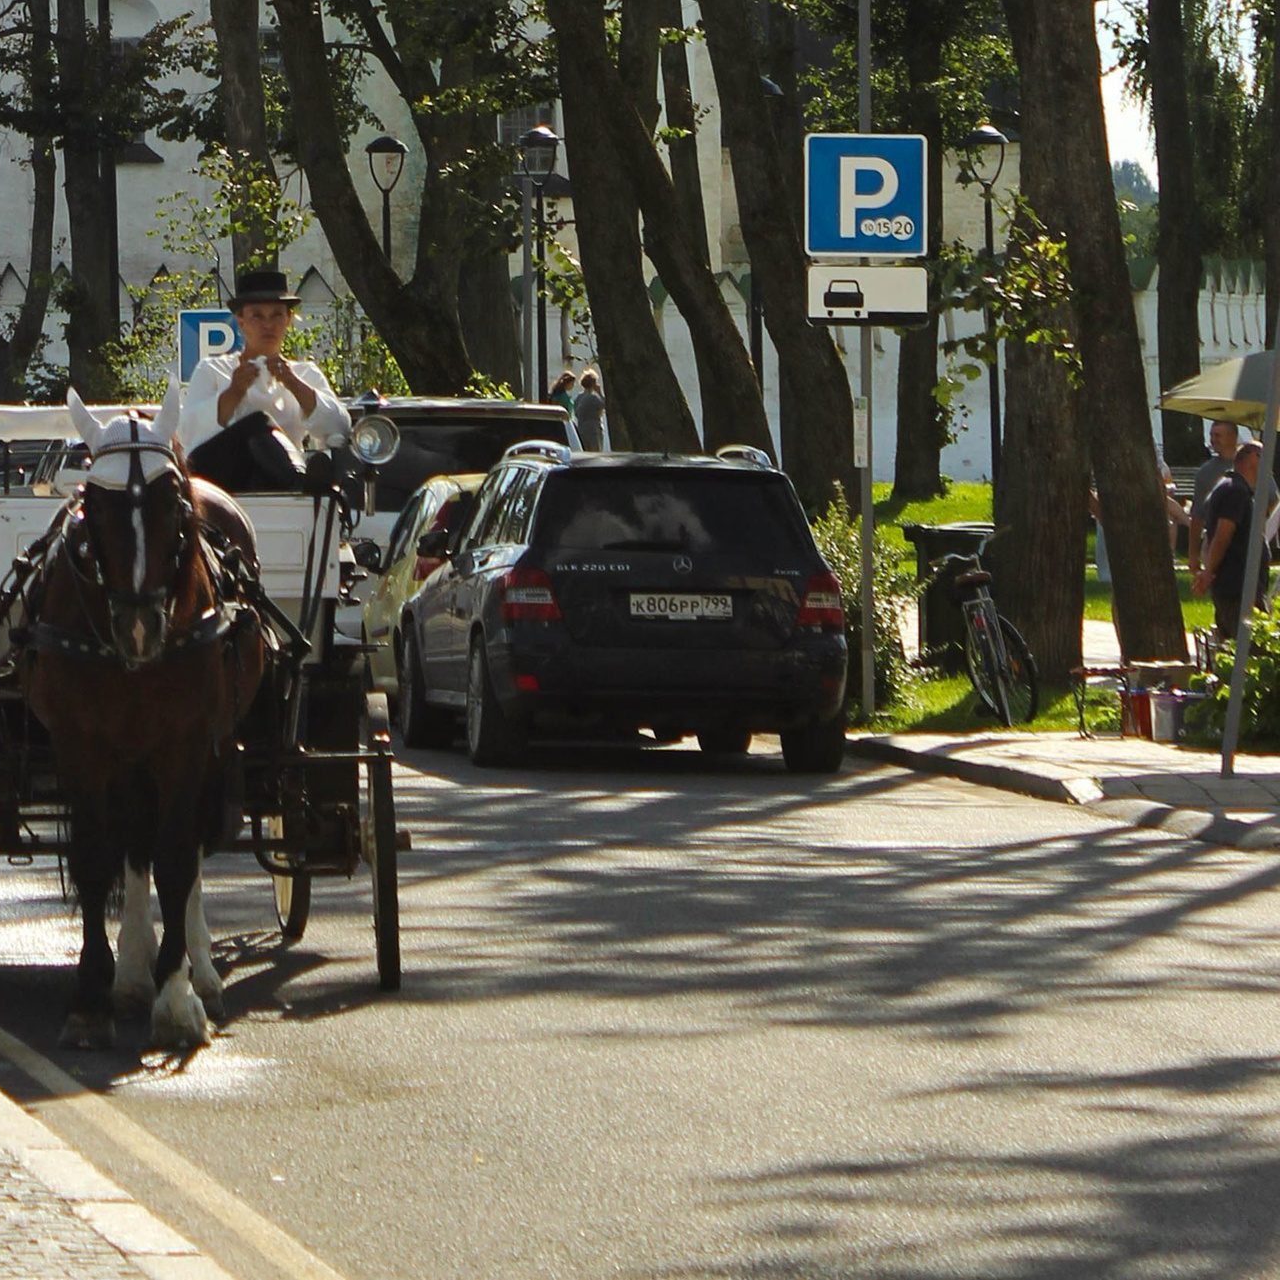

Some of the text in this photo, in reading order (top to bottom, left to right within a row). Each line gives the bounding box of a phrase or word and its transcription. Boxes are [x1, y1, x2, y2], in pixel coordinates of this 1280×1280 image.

[839, 156, 899, 238] P
[864, 221, 913, 235] 10 15 20
[199, 322, 235, 359] P
[635, 596, 728, 613] К806РР 799
